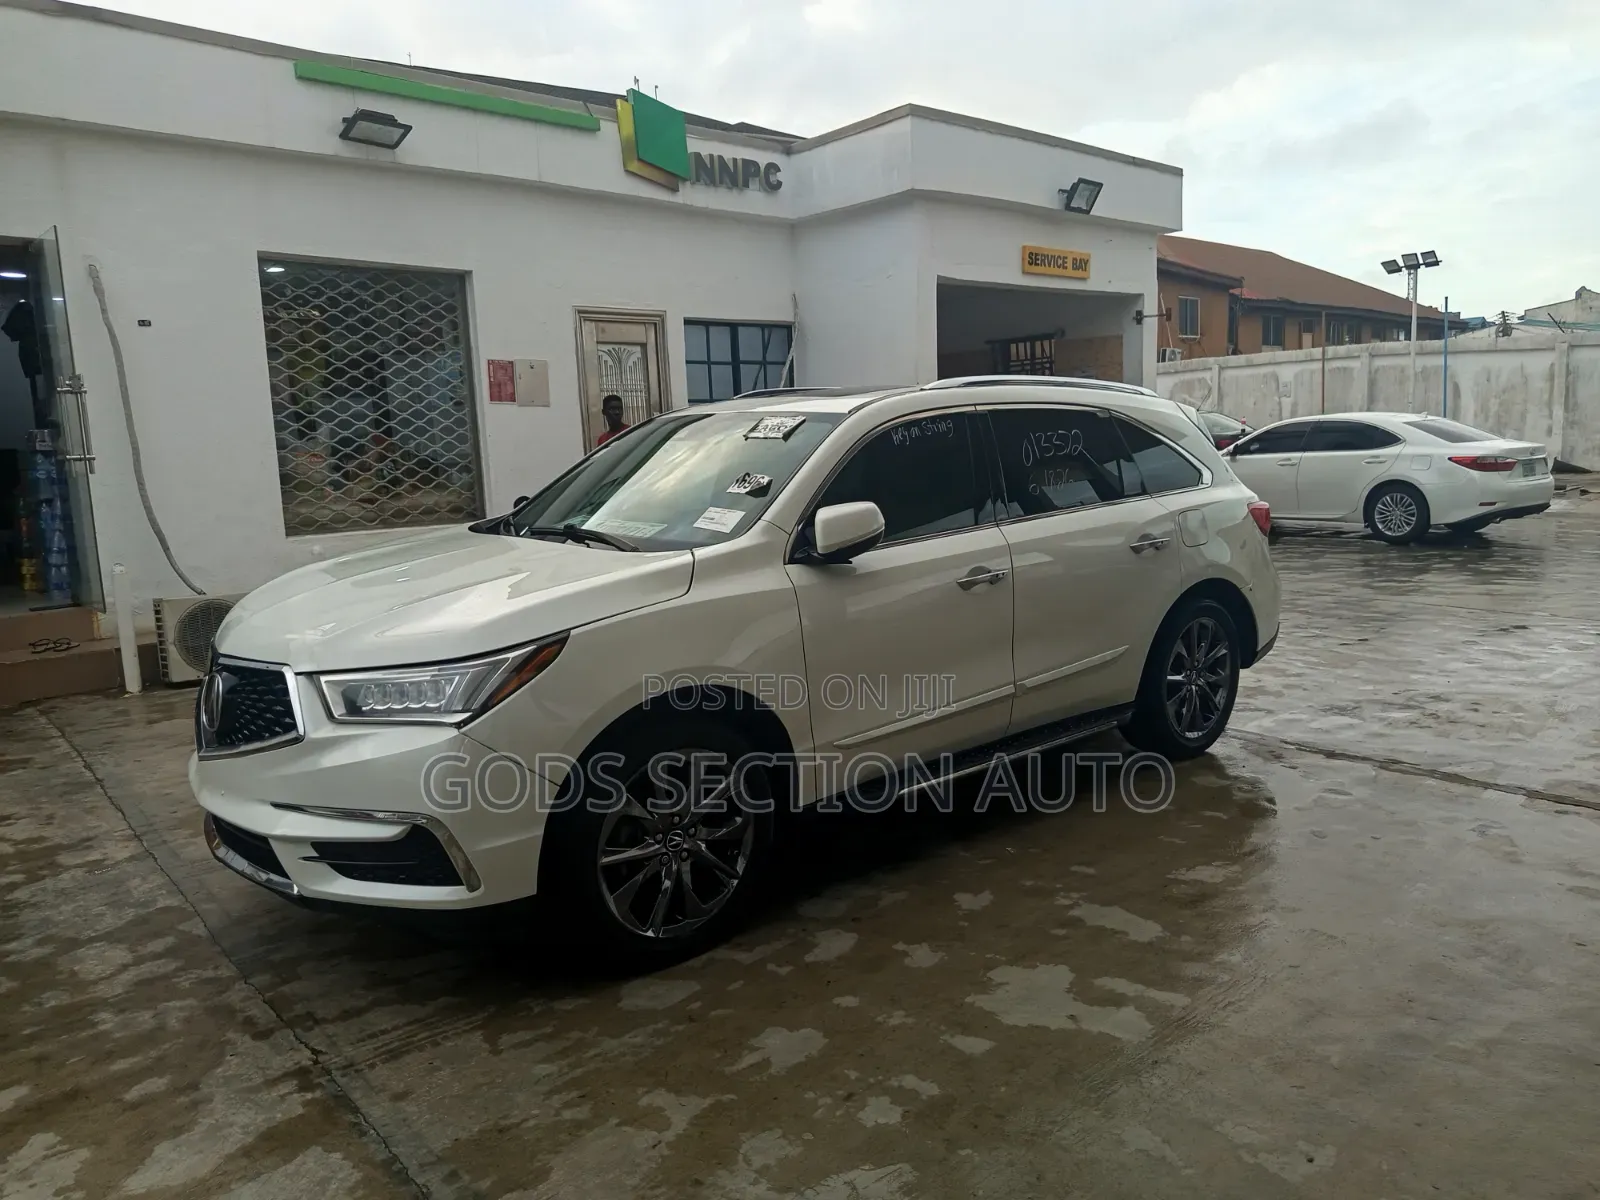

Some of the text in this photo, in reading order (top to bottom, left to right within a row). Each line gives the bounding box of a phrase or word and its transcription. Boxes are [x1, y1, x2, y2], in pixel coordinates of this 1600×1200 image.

[689, 151, 783, 191] NNPC
[1027, 251, 1089, 272] SERVICE BAY
